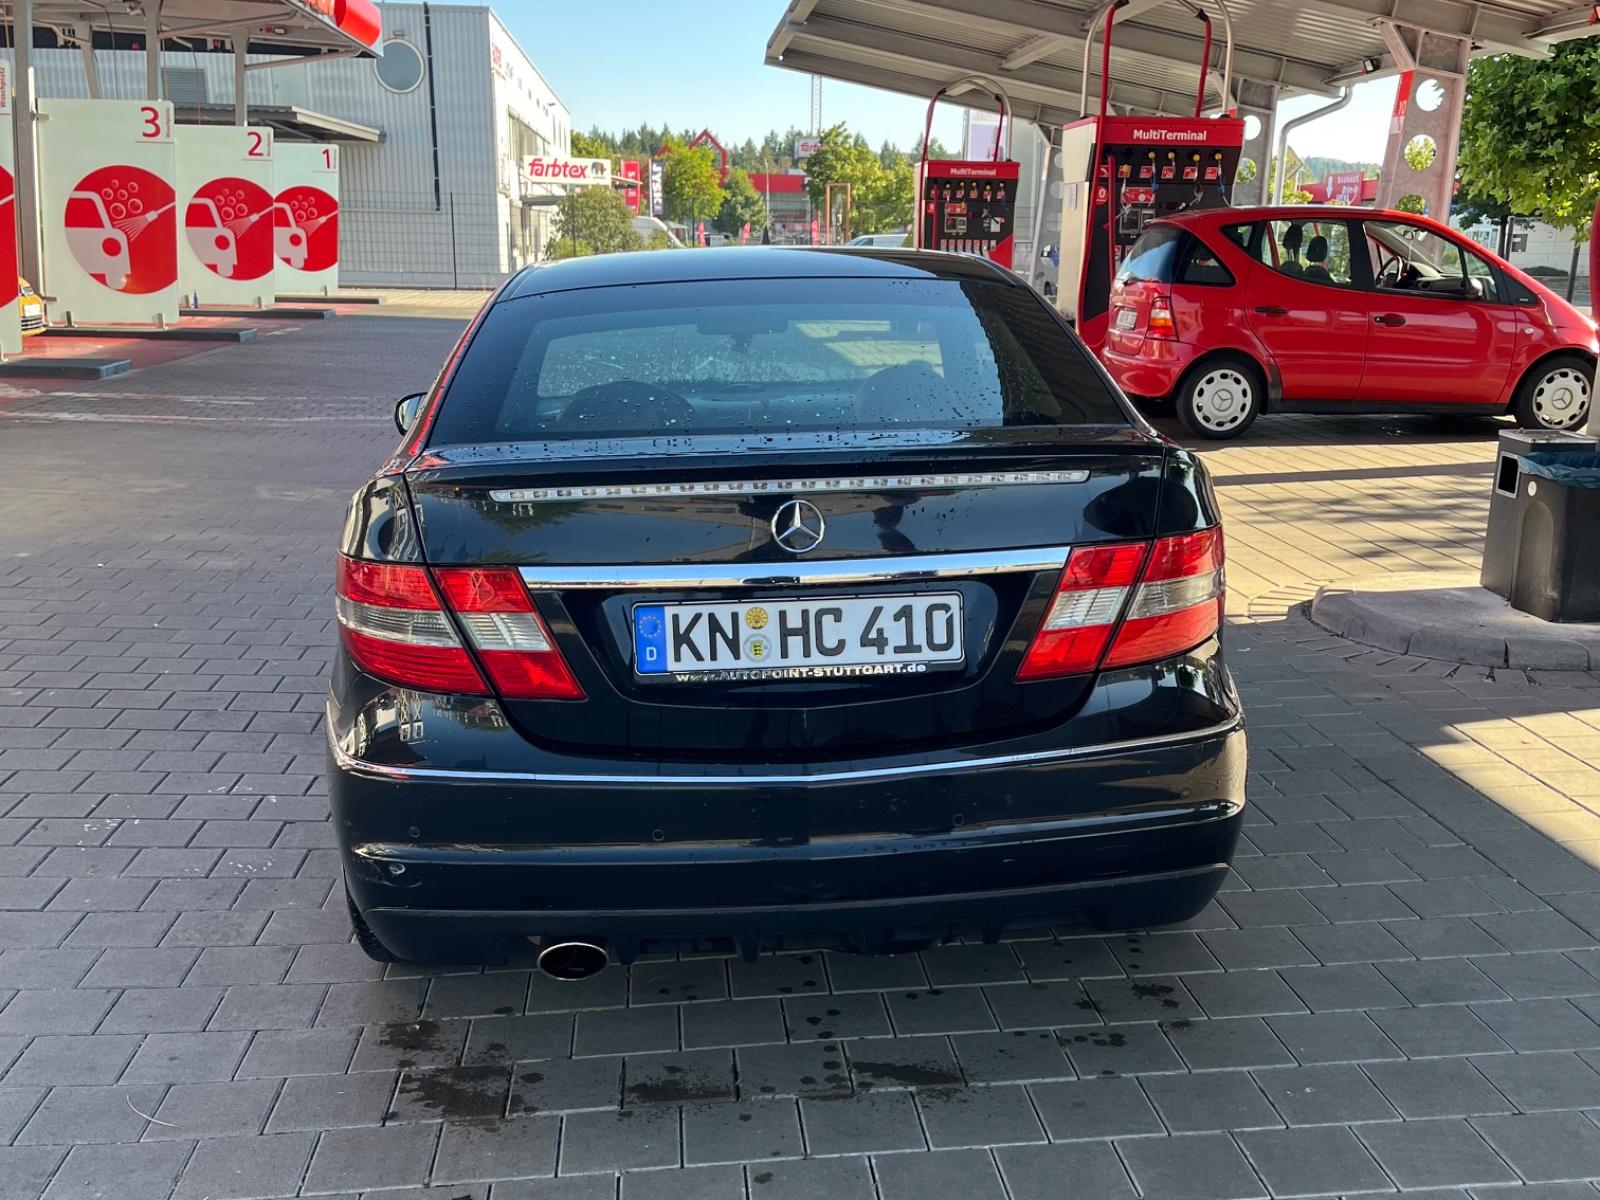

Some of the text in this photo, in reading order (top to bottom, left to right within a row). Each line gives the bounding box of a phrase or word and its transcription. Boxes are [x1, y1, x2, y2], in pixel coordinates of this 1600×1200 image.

[141, 106, 161, 138] 3
[247, 131, 264, 156] 2
[1133, 129, 1207, 141] MultiTerminal
[322, 148, 331, 169] 1
[528, 158, 588, 179] farbtex
[950, 167, 997, 176] MultiTerminal
[672, 602, 955, 662] KN HC 410
[646, 647, 657, 661] D
